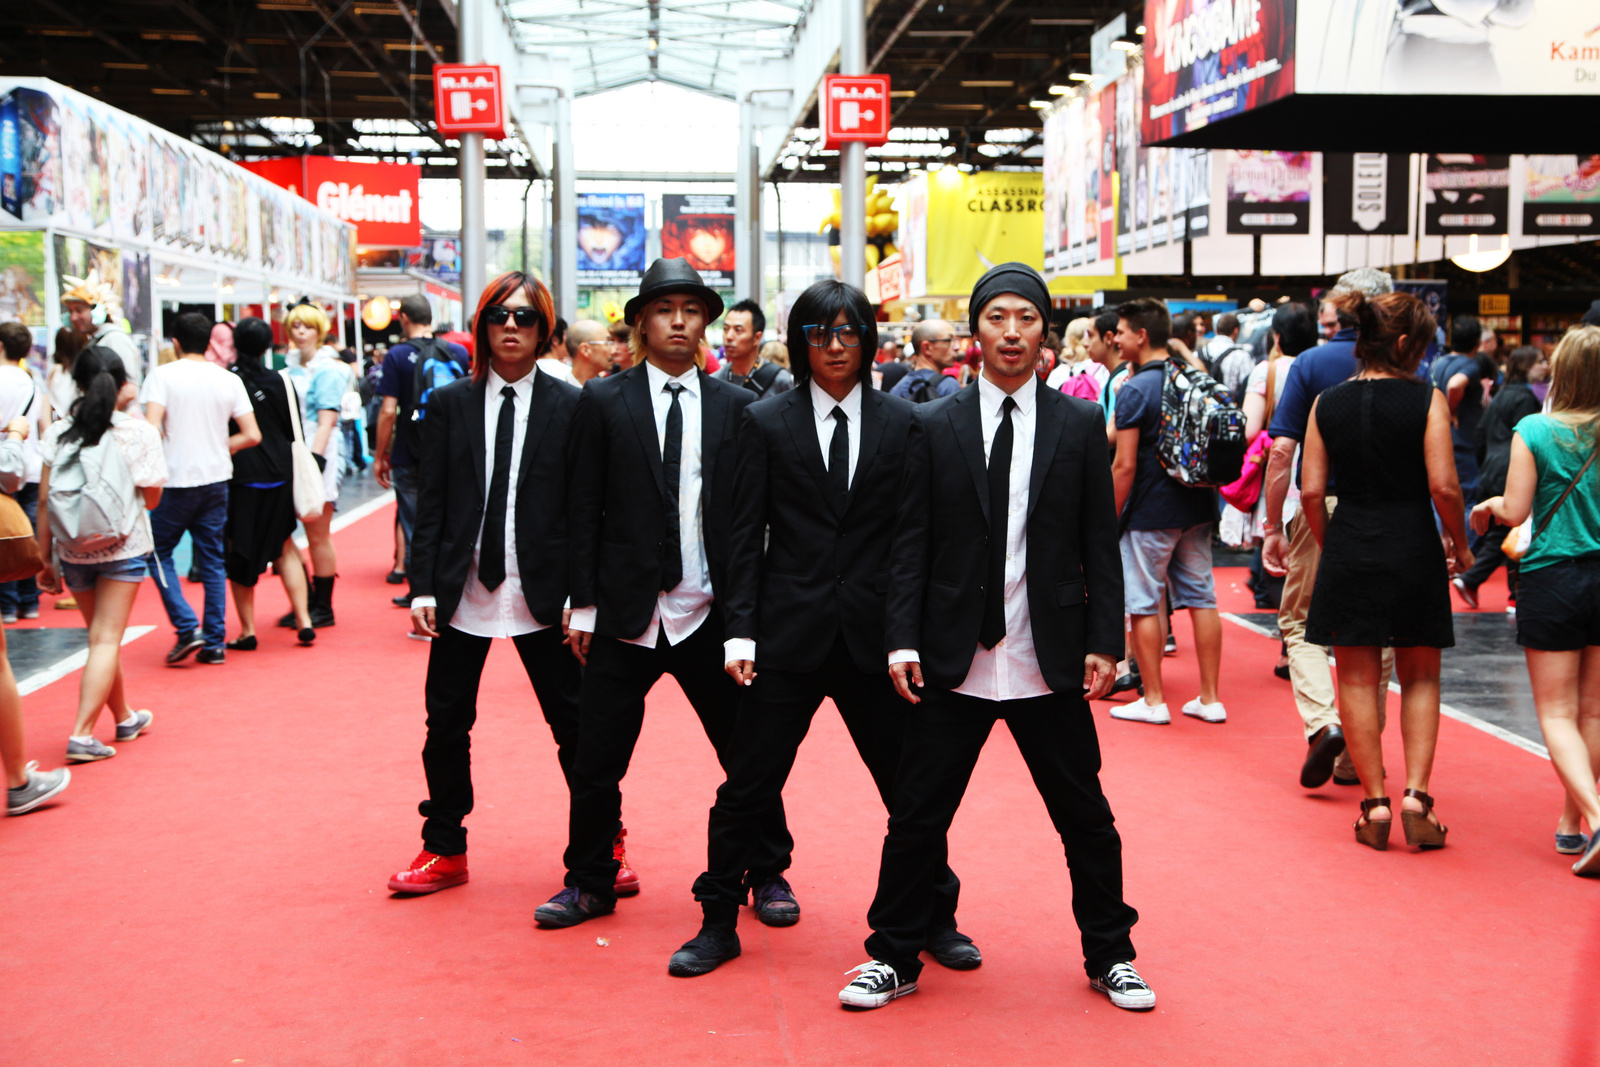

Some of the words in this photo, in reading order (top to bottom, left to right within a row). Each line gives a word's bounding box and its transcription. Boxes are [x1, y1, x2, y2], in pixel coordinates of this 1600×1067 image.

[1551, 42, 1600, 60] Kam
[1575, 68, 1597, 81] Du
[316, 181, 413, 224] Glénat
